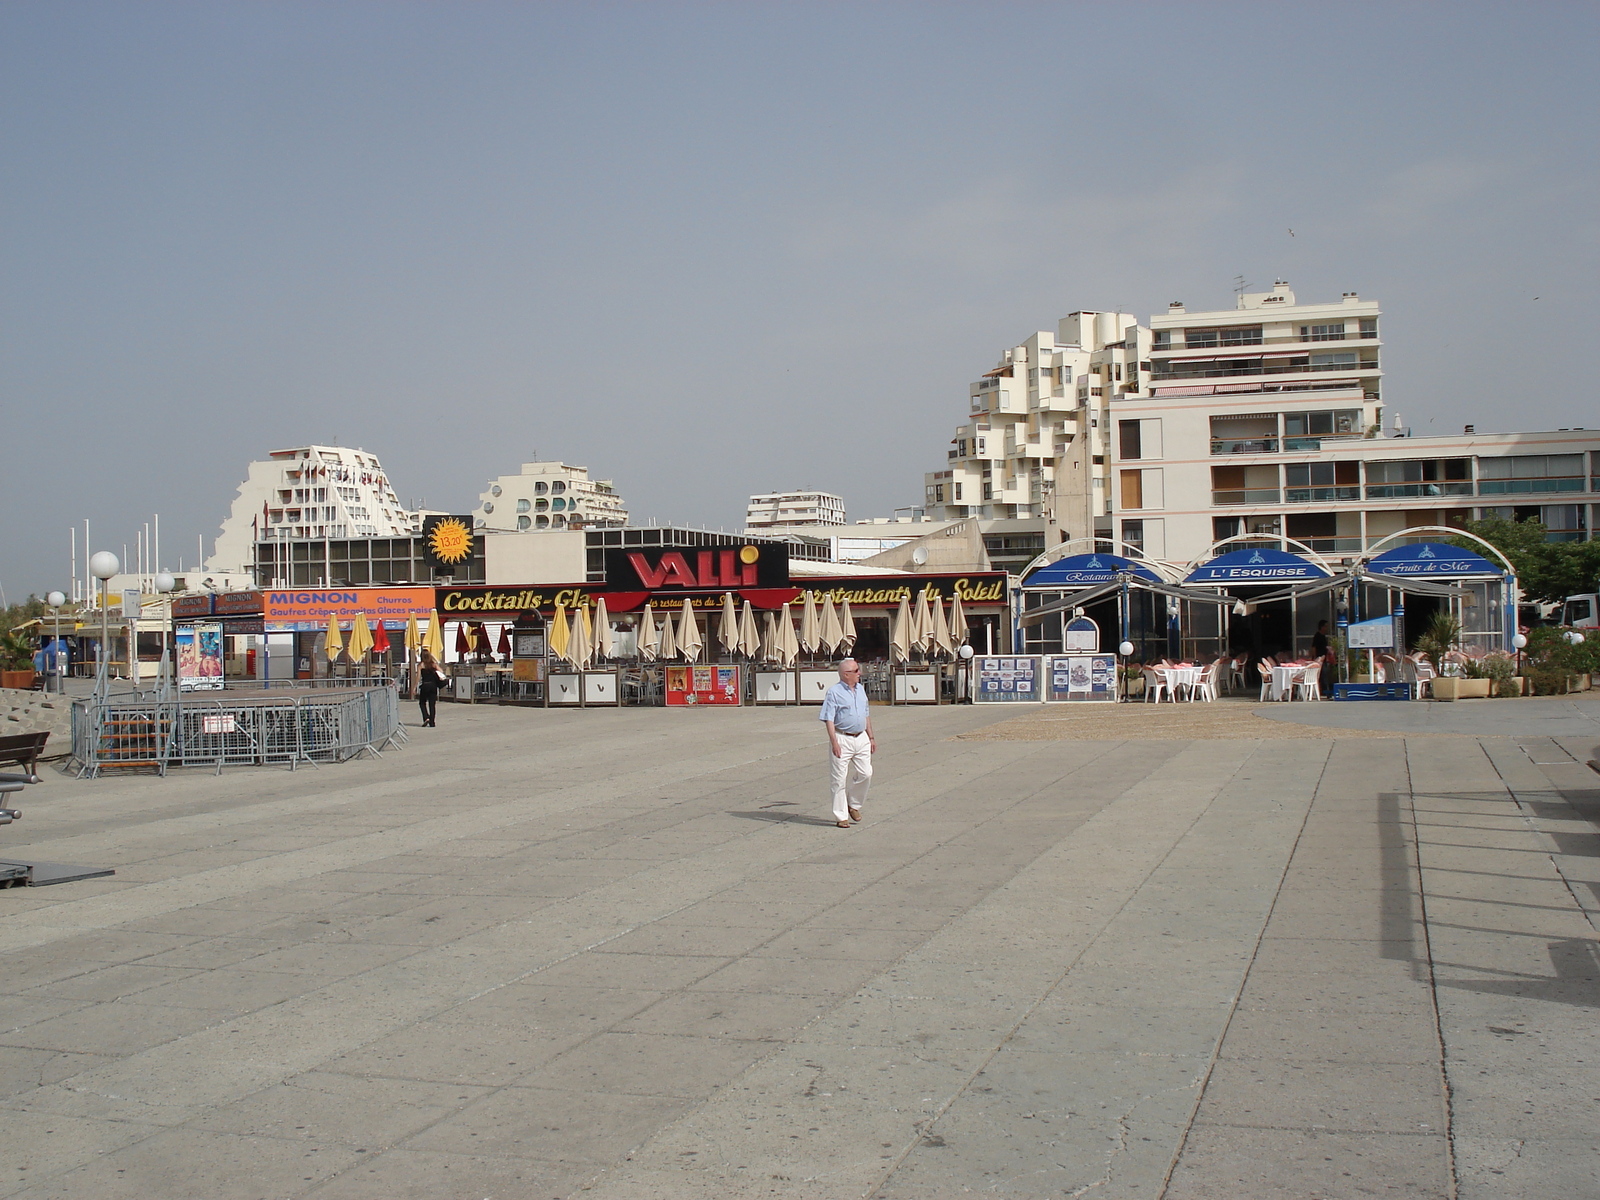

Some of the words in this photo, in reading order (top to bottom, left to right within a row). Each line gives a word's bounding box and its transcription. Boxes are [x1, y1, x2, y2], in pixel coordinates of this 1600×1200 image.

[1229, 568, 1306, 577] ESQUISSE
[1382, 562, 1422, 575] Fruits
[1423, 562, 1437, 571] de
[1439, 561, 1471, 571] Mer
[1065, 572, 1120, 582] Restauran
[946, 578, 1003, 601] Soleil
[269, 592, 358, 604] MIGNON
[376, 596, 412, 604] Churros
[443, 590, 542, 611] Cocktails
[269, 608, 307, 616] Gaufres
[377, 606, 405, 615] Glaces
